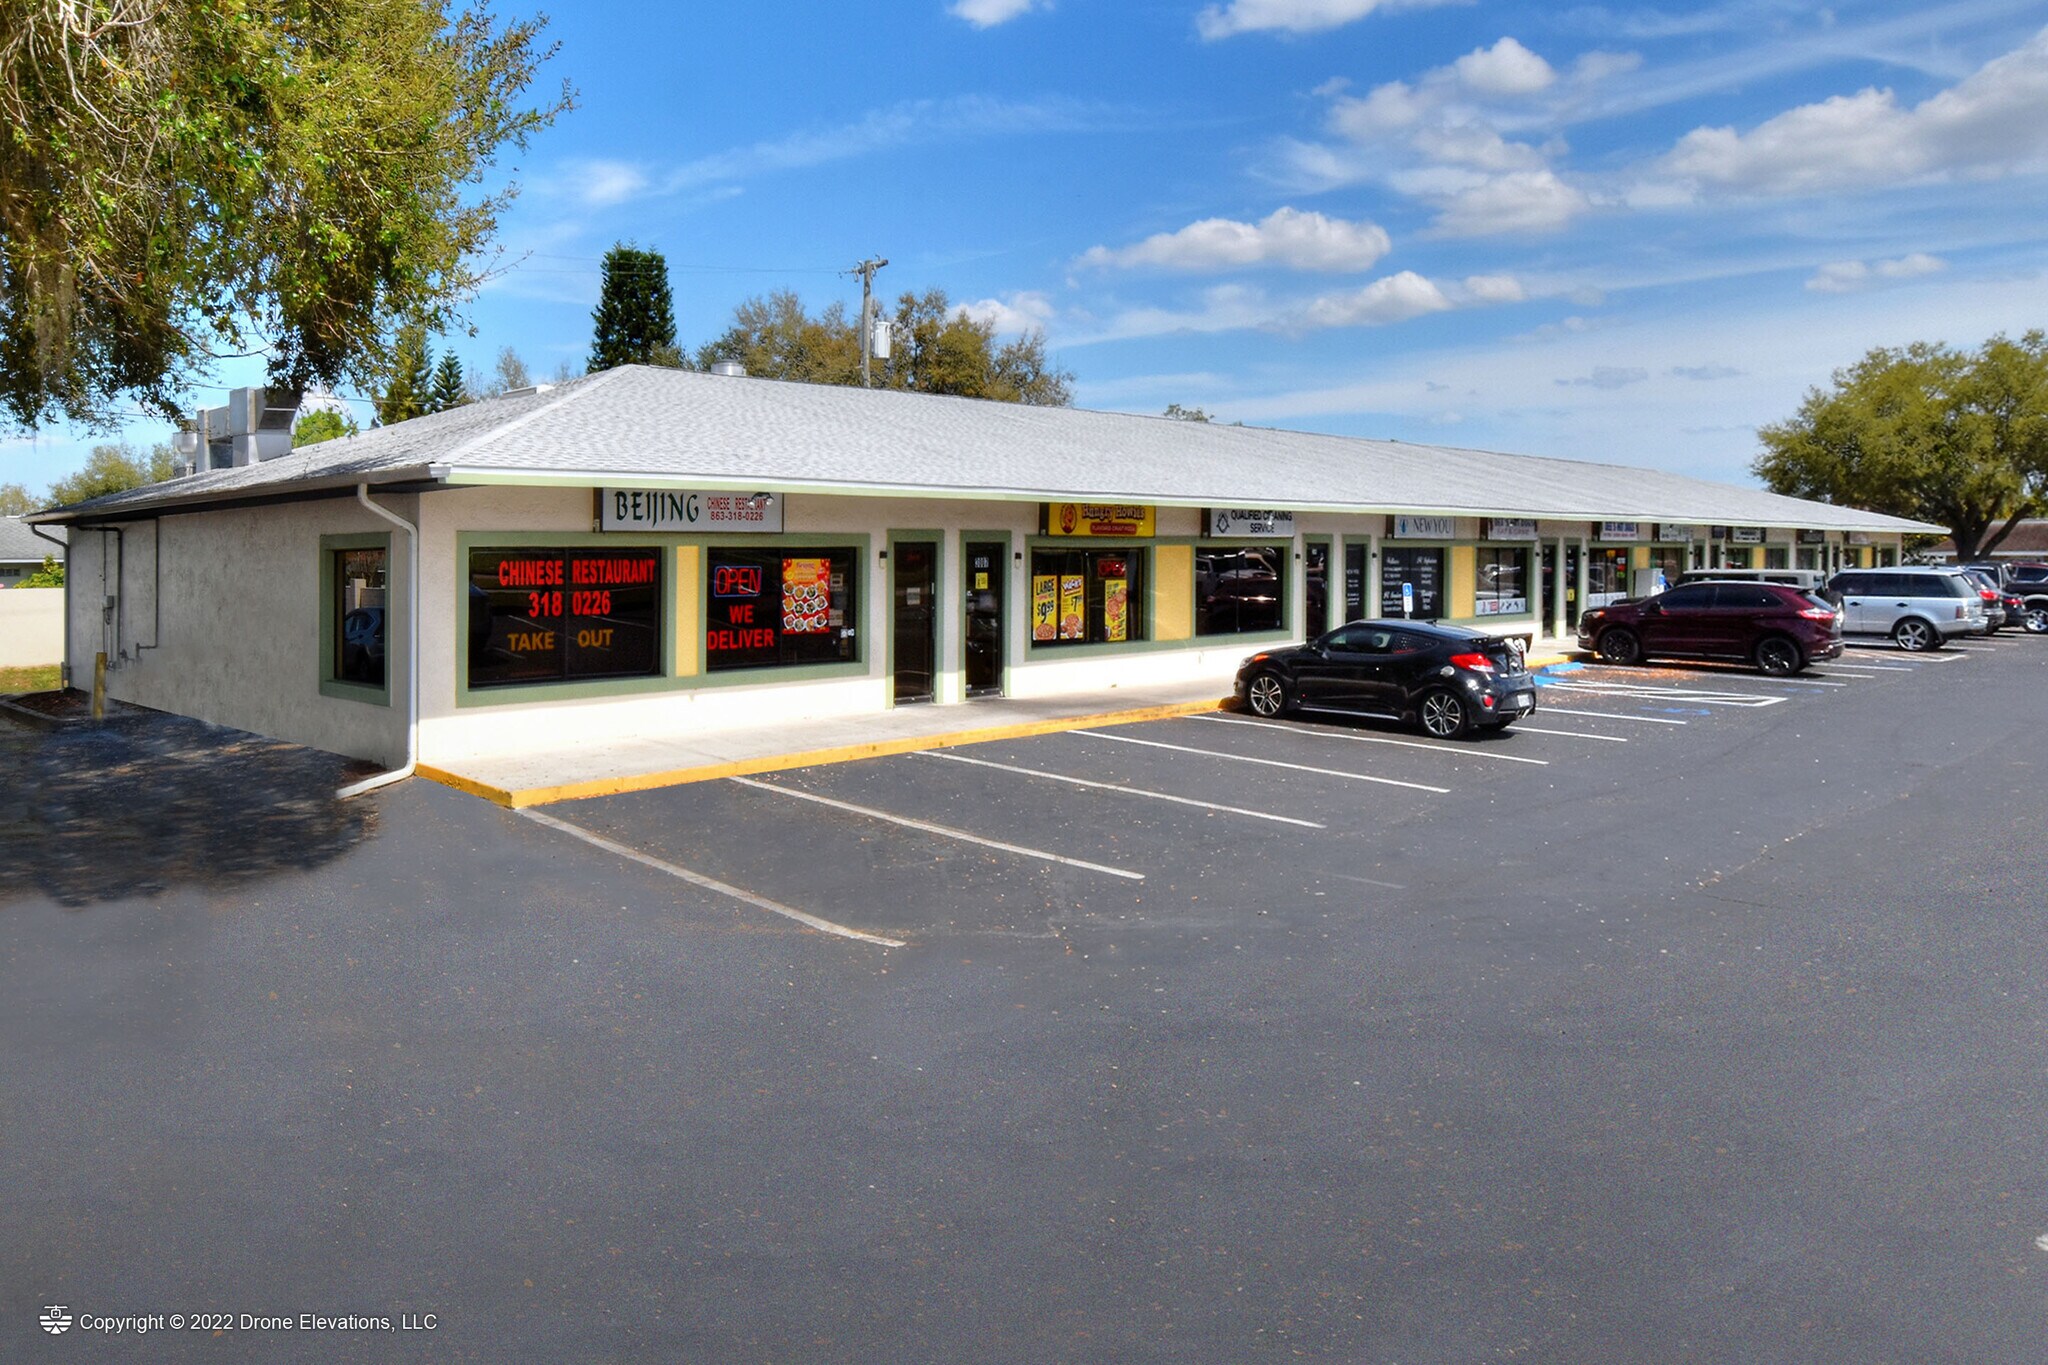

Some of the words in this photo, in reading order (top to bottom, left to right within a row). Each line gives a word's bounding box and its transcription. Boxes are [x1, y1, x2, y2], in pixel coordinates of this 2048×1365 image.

[614, 491, 700, 528] BEIJING
[707, 497, 730, 510] CHINESE
[710, 511, 764, 521] 863-318-0226
[1231, 510, 1261, 521] QUALIFIED
[499, 560, 564, 586] CHINESE
[572, 559, 656, 584] RESTAURANT
[716, 568, 762, 595] OPEN
[528, 591, 563, 618] 318
[572, 590, 611, 616] 0226
[729, 604, 755, 624] WE
[507, 631, 555, 651] TAKE
[577, 629, 614, 648] OUT
[707, 628, 775, 650] DELIVER
